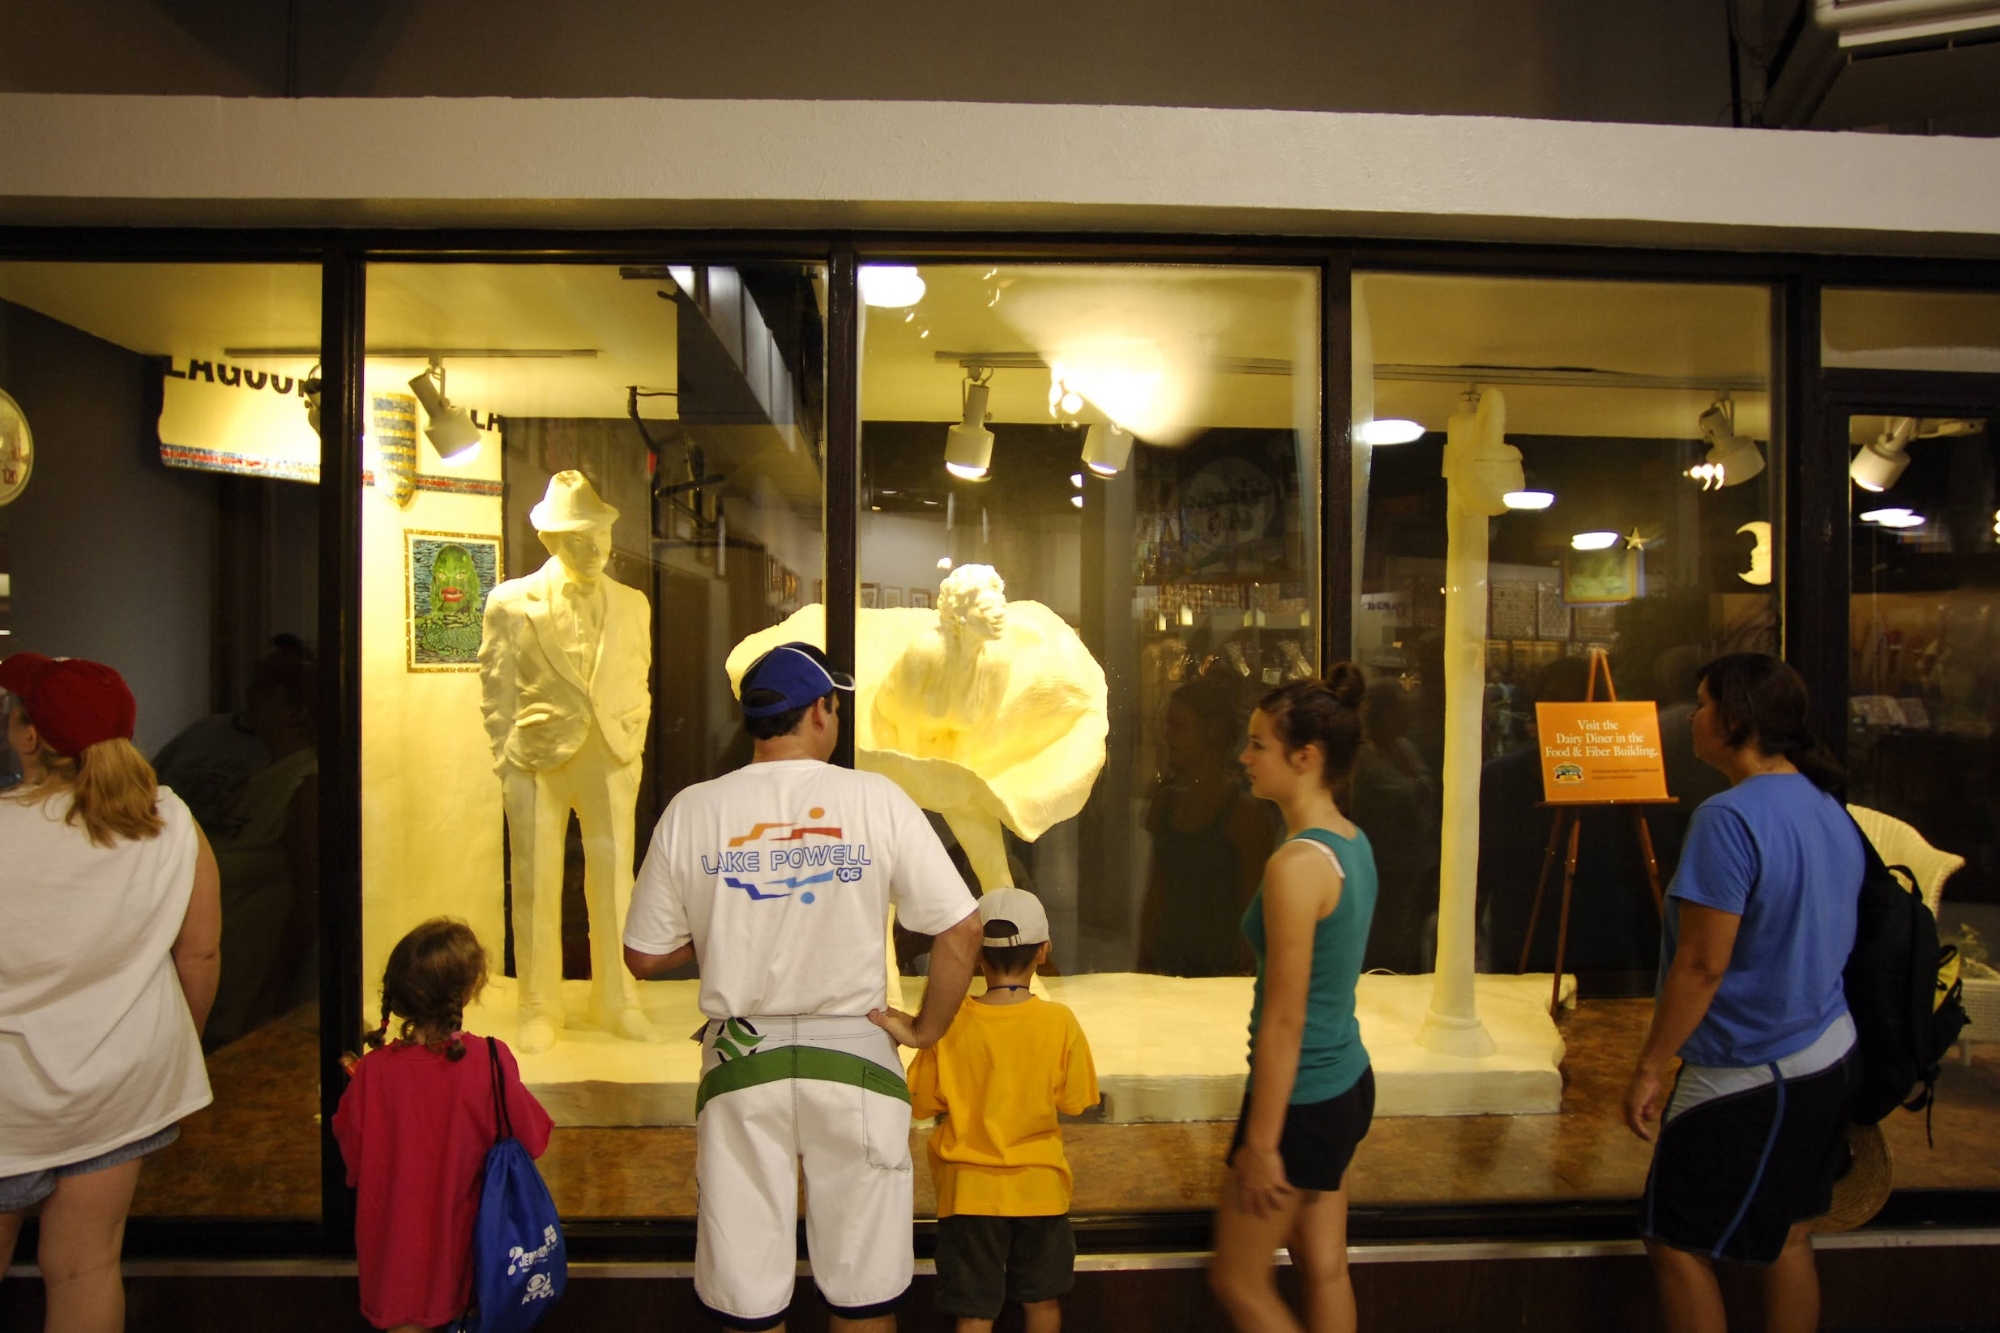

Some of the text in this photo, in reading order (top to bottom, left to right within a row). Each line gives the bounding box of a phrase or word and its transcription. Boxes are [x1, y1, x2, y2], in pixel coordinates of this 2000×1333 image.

[1577, 719, 1619, 730] Visit the
[1556, 731, 1645, 746] Dairy Diner in the
[1545, 745, 1659, 758] Food & Fiber Building.
[701, 844, 872, 875] LAKE POWELL
[836, 867, 863, 883] '06
